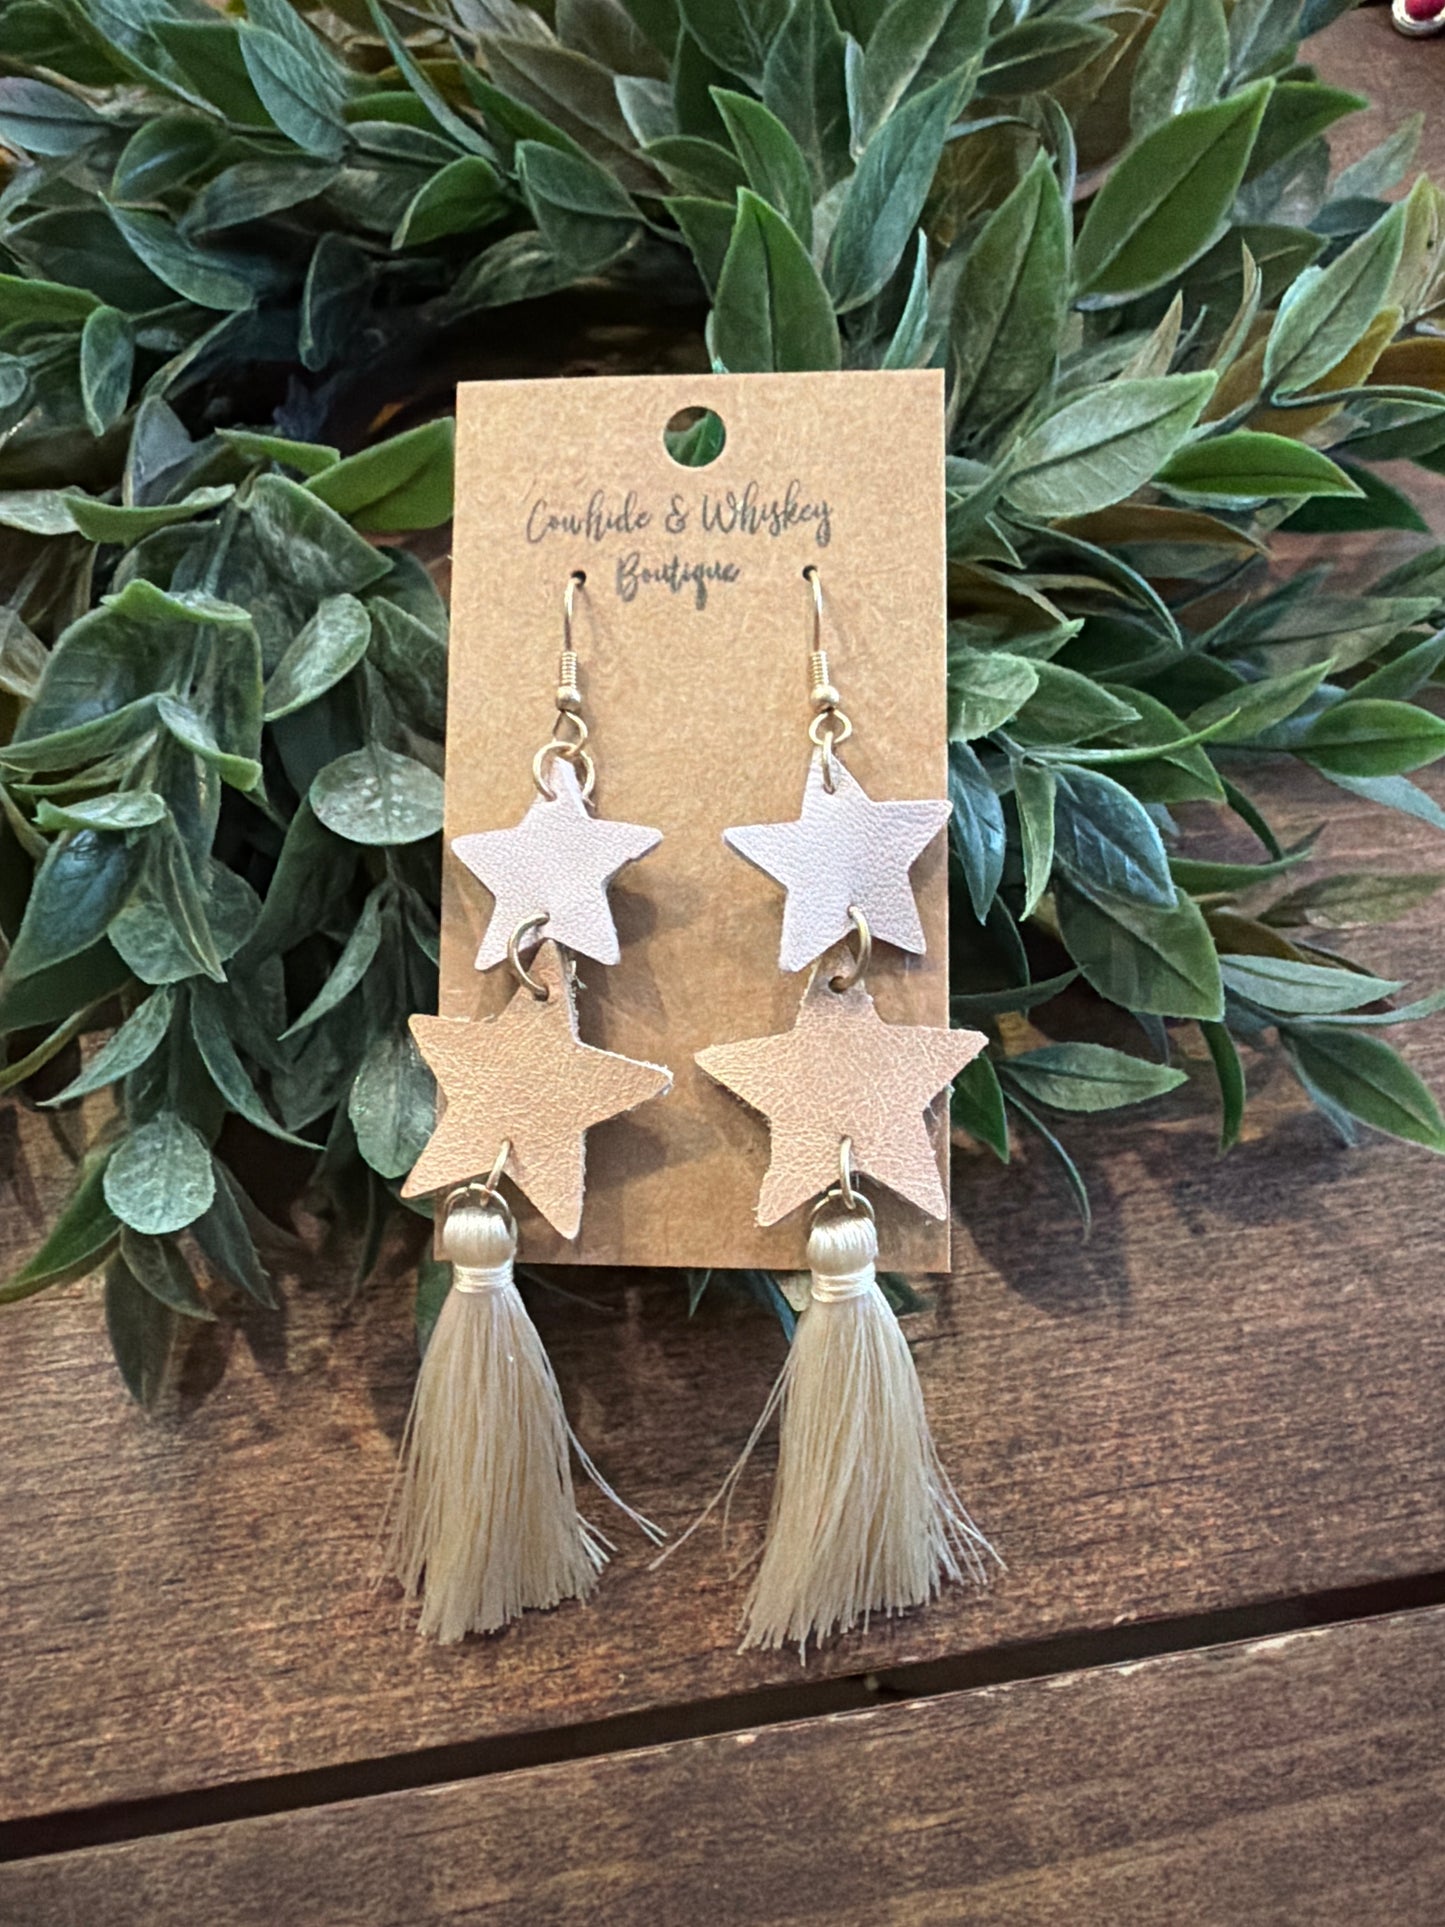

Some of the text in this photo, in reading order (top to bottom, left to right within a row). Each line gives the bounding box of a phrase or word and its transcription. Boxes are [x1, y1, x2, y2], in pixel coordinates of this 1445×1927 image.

[526, 479, 834, 548] Cowhide & Whiskey
[616, 551, 741, 611] Boutique
